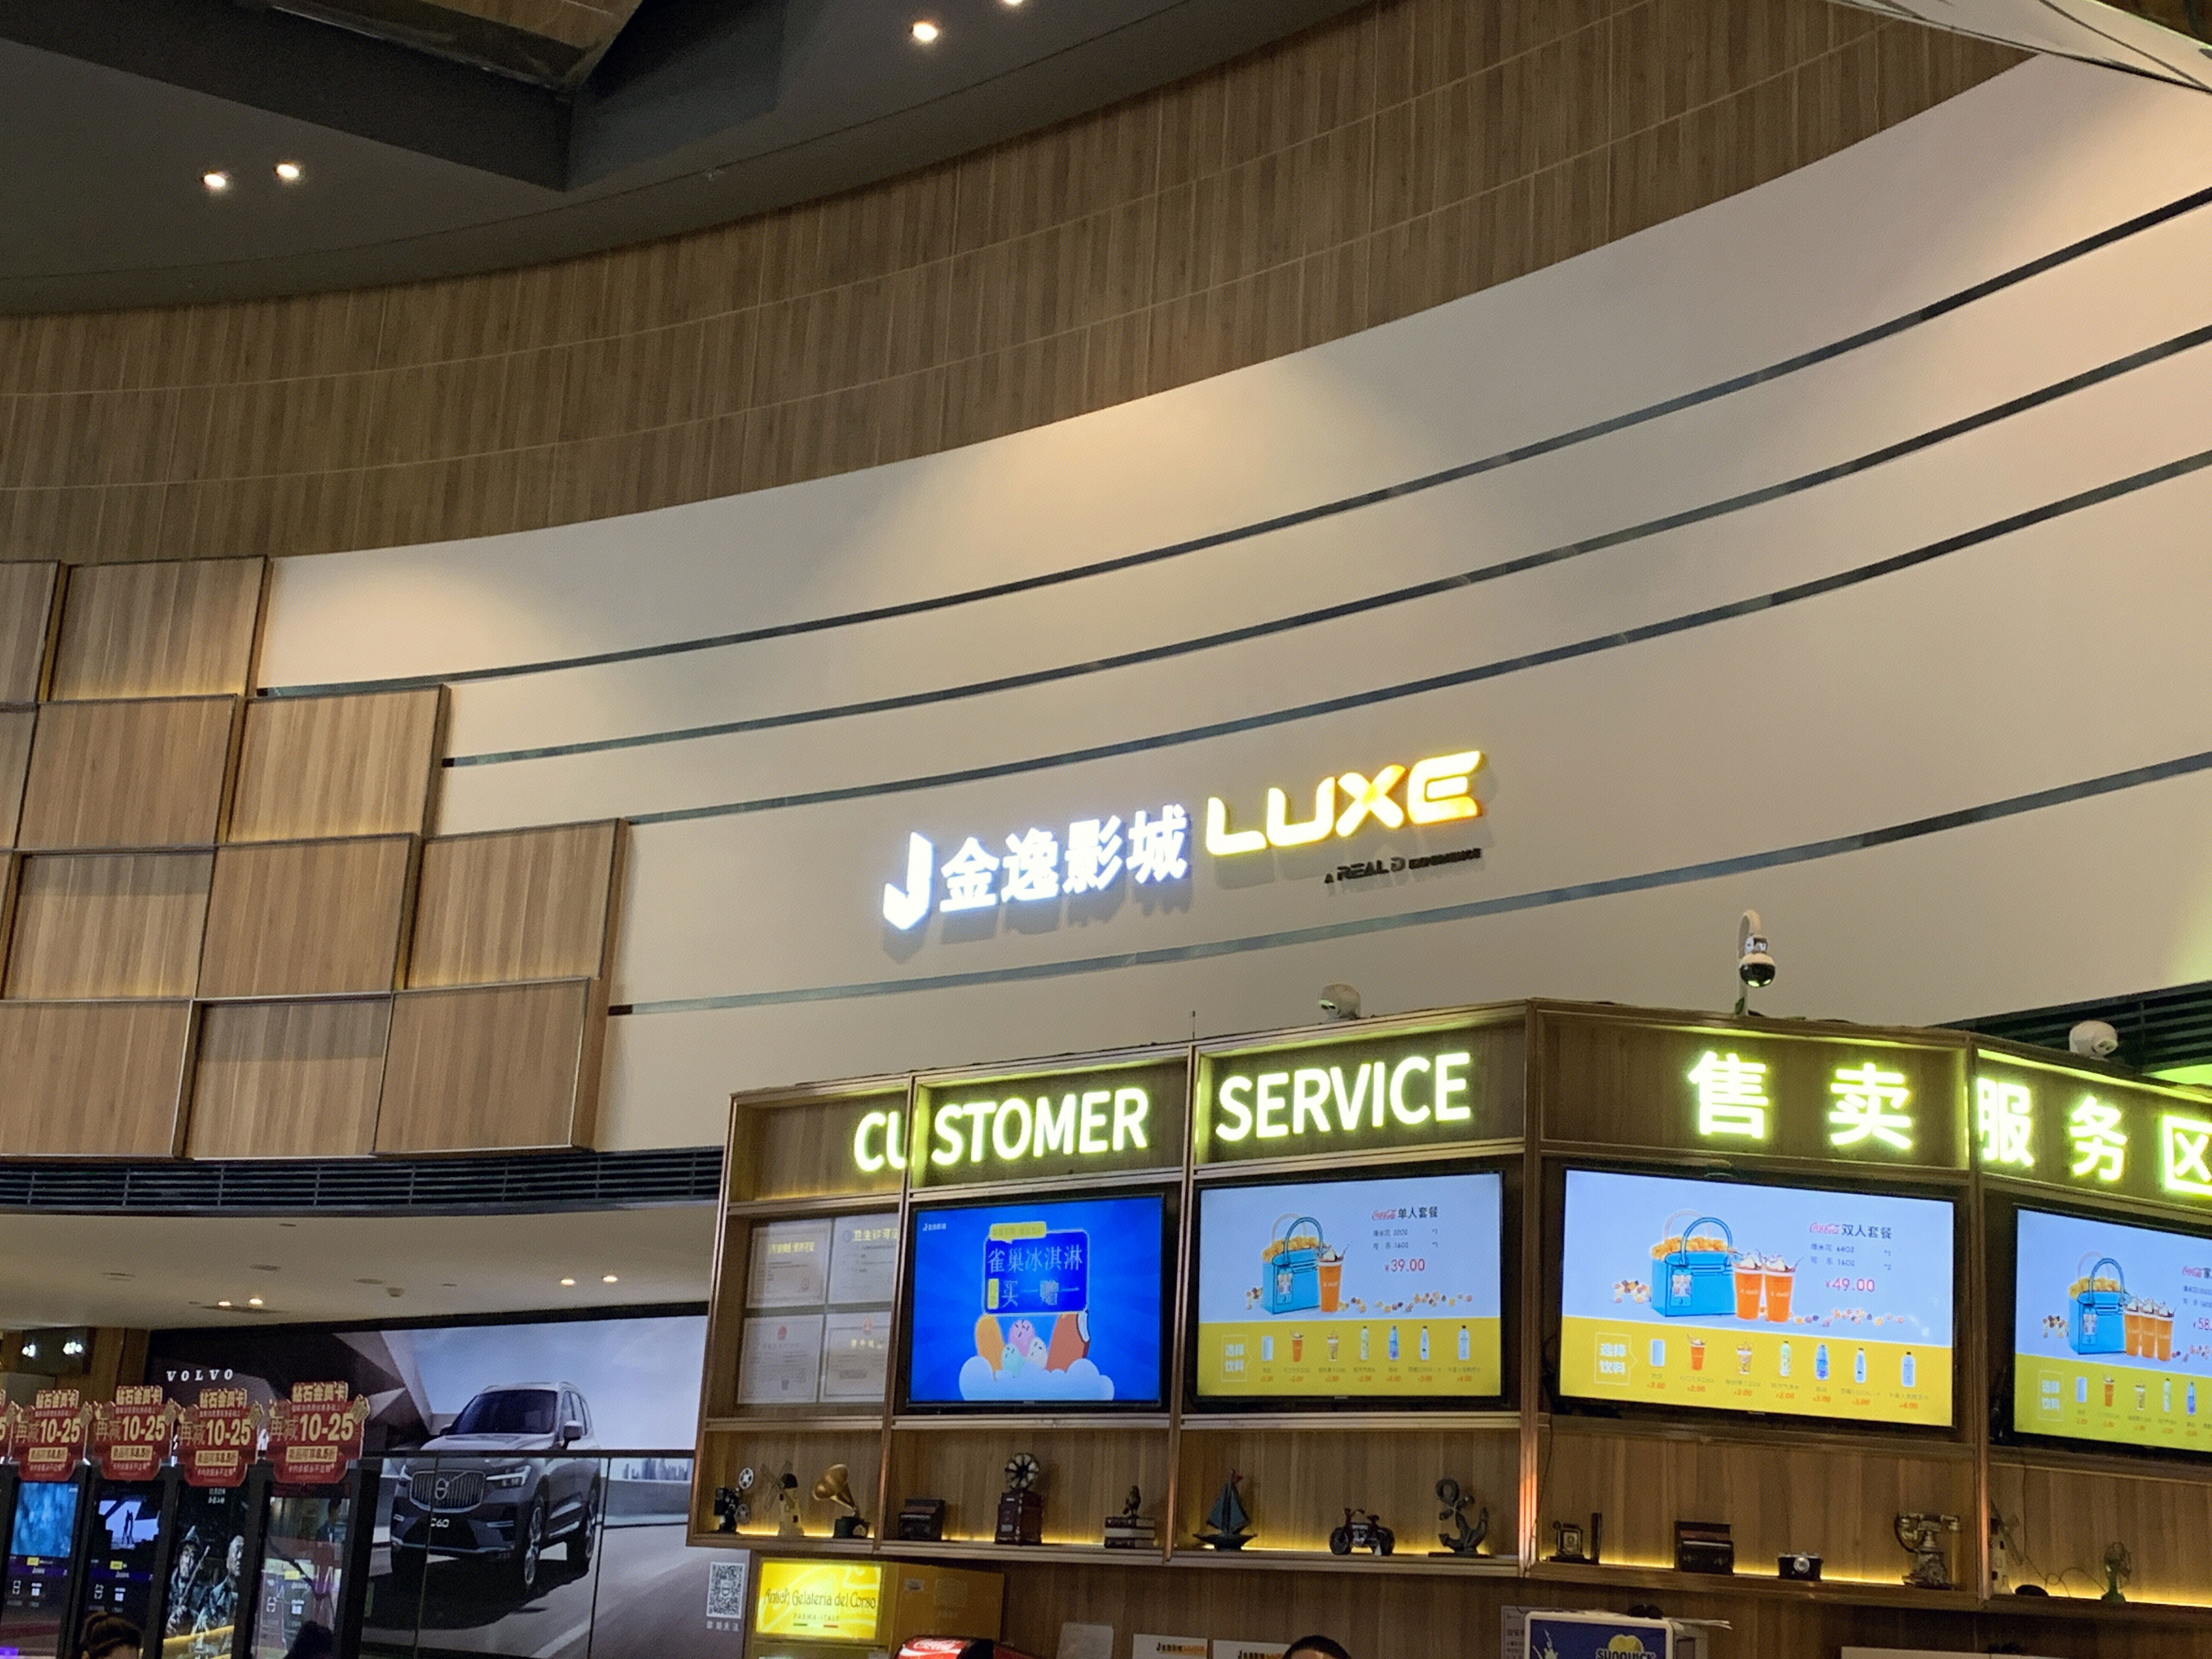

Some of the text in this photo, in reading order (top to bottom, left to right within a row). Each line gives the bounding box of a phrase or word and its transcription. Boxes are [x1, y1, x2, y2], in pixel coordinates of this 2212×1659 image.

[940, 804, 1188, 912] 金逸影城
[1206, 750, 1482, 855] LUXE
[854, 1052, 1471, 1172] CUSTOMER SERVICE
[1397, 1206, 1438, 1219] 单人套餐
[1842, 1223, 1892, 1239] 双人套餐
[988, 1244, 1083, 1273] 雀巢冰淇淋
[1385, 1259, 1425, 1272] ¥39.00
[1825, 1278, 1875, 1293] ¥49.00
[167, 1368, 233, 1381] VOLVO
[40, 1418, 81, 1443] 10-25
[122, 1415, 165, 1441] 10-25
[206, 1418, 251, 1446] 10-25
[300, 1413, 354, 1442] 10-25
[792, 1590, 832, 1606] Gelateria
[834, 1592, 849, 1607] del
[850, 1592, 876, 1609] Corso
